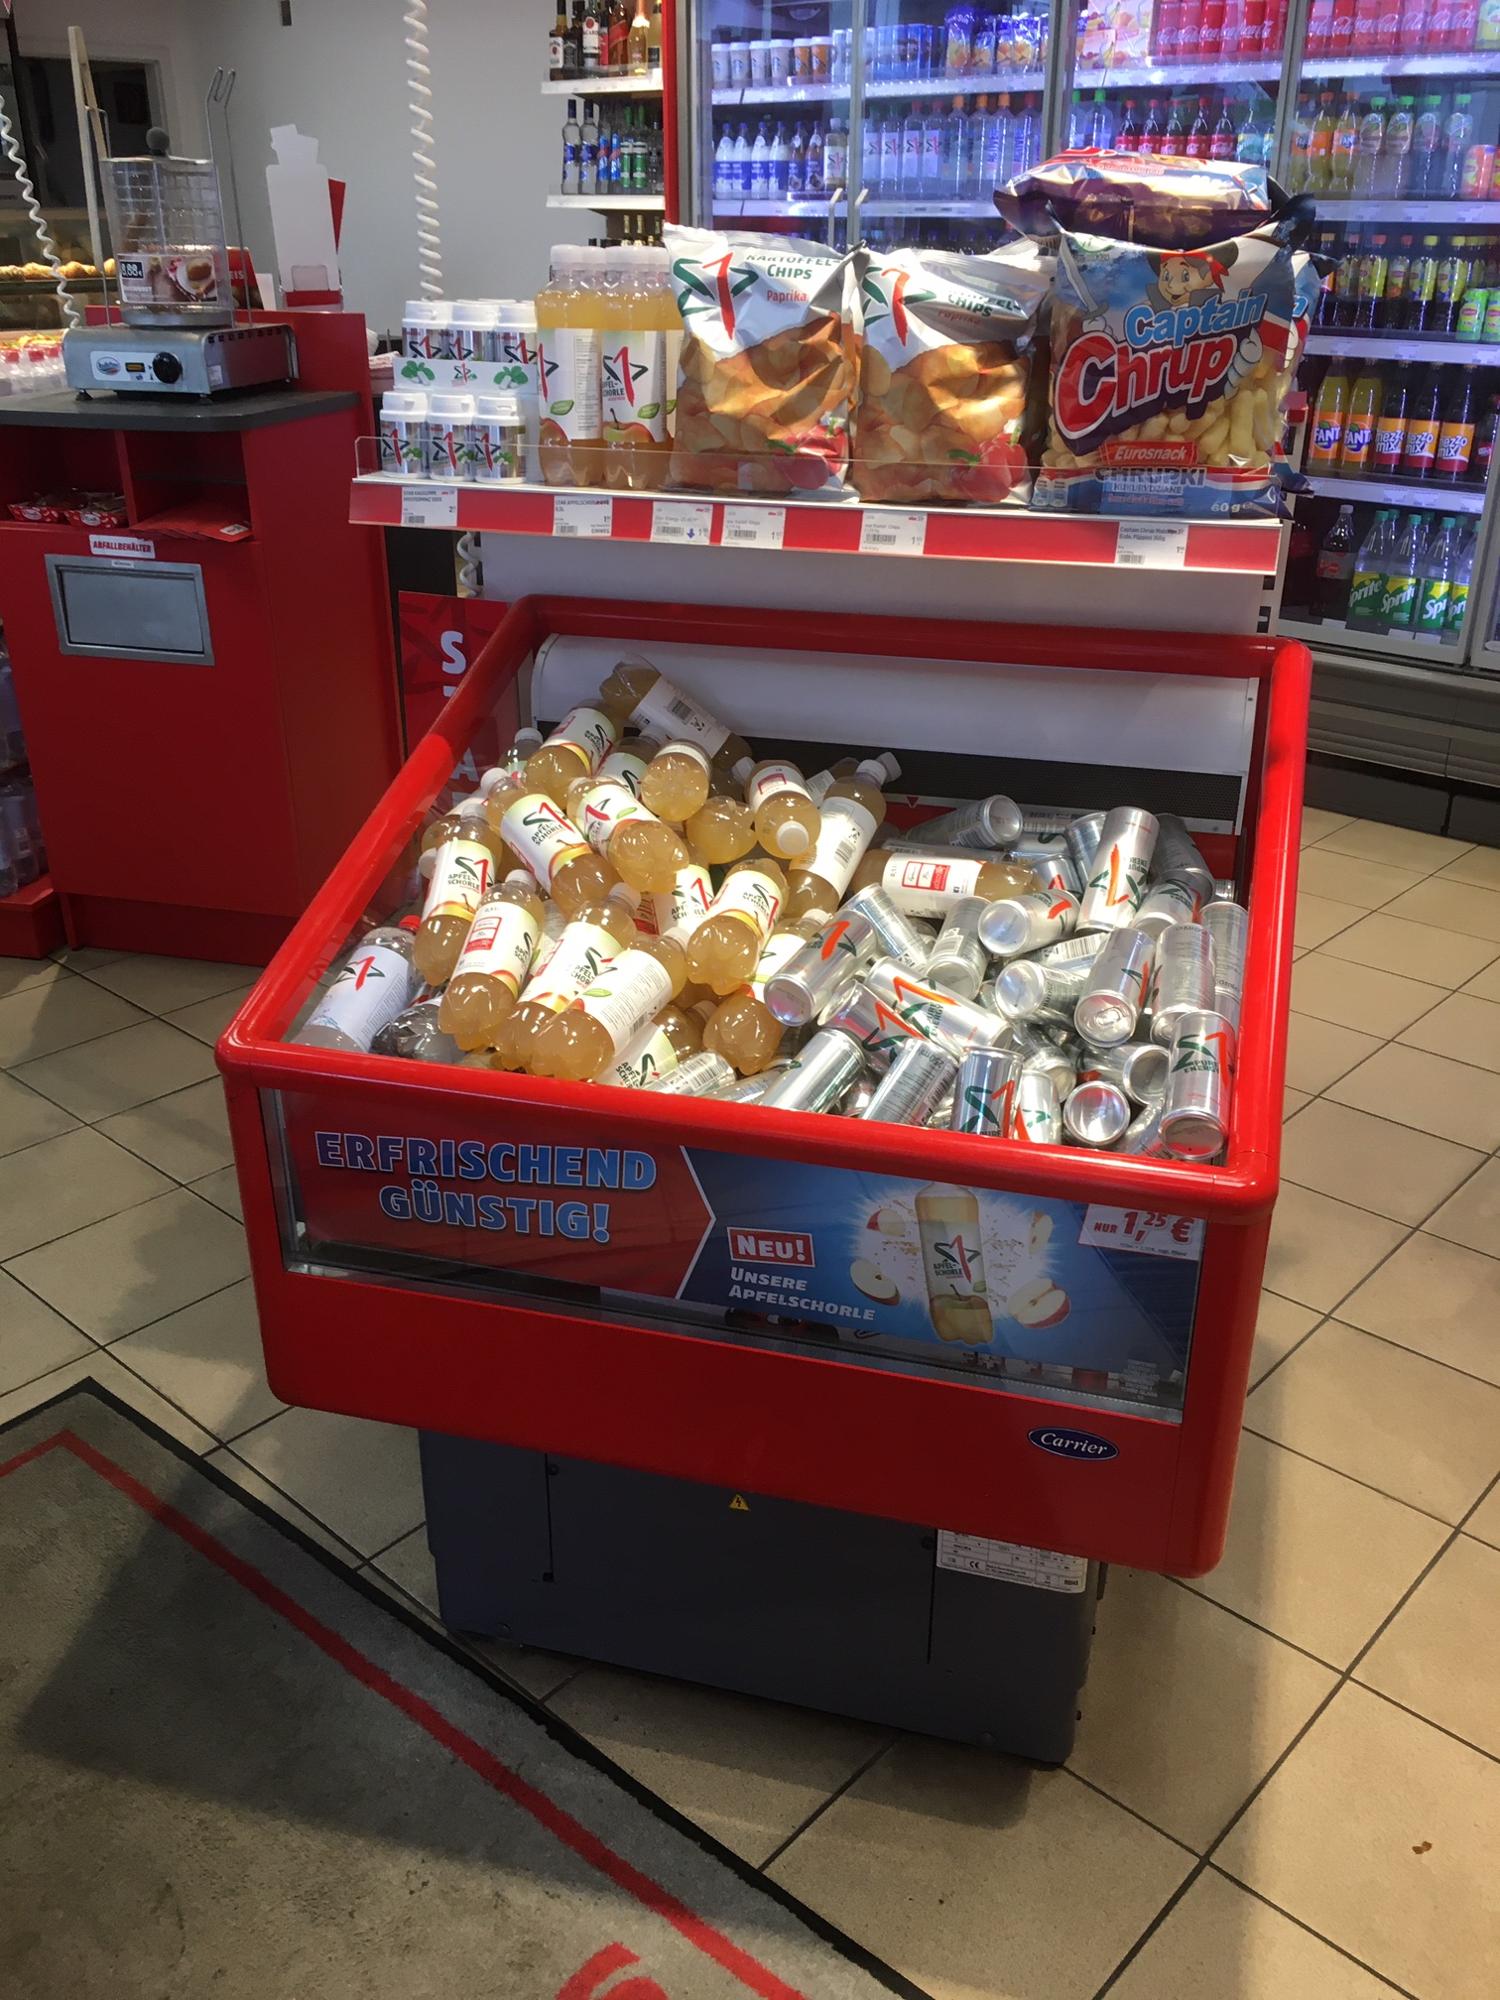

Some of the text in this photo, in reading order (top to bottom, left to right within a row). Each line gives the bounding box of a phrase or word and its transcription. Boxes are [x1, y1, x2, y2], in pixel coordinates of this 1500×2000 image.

[766, 264, 812, 280] CHIPS
[766, 290, 808, 303] Paprika
[1124, 286, 1267, 348] Captain
[1055, 331, 1237, 440] Chrup
[1344, 426, 1372, 445] FANT
[1114, 445, 1188, 462] Eurosnack
[1211, 502, 1240, 514] 60 g
[92, 540, 152, 553] ABFALLBEHÄLTER
[314, 1132, 656, 1190] ERFRISCHEND
[378, 1180, 610, 1243] GÜNSTIG!
[1094, 1222, 1118, 1234] NUR
[1040, 1432, 1108, 1455] Carrier
